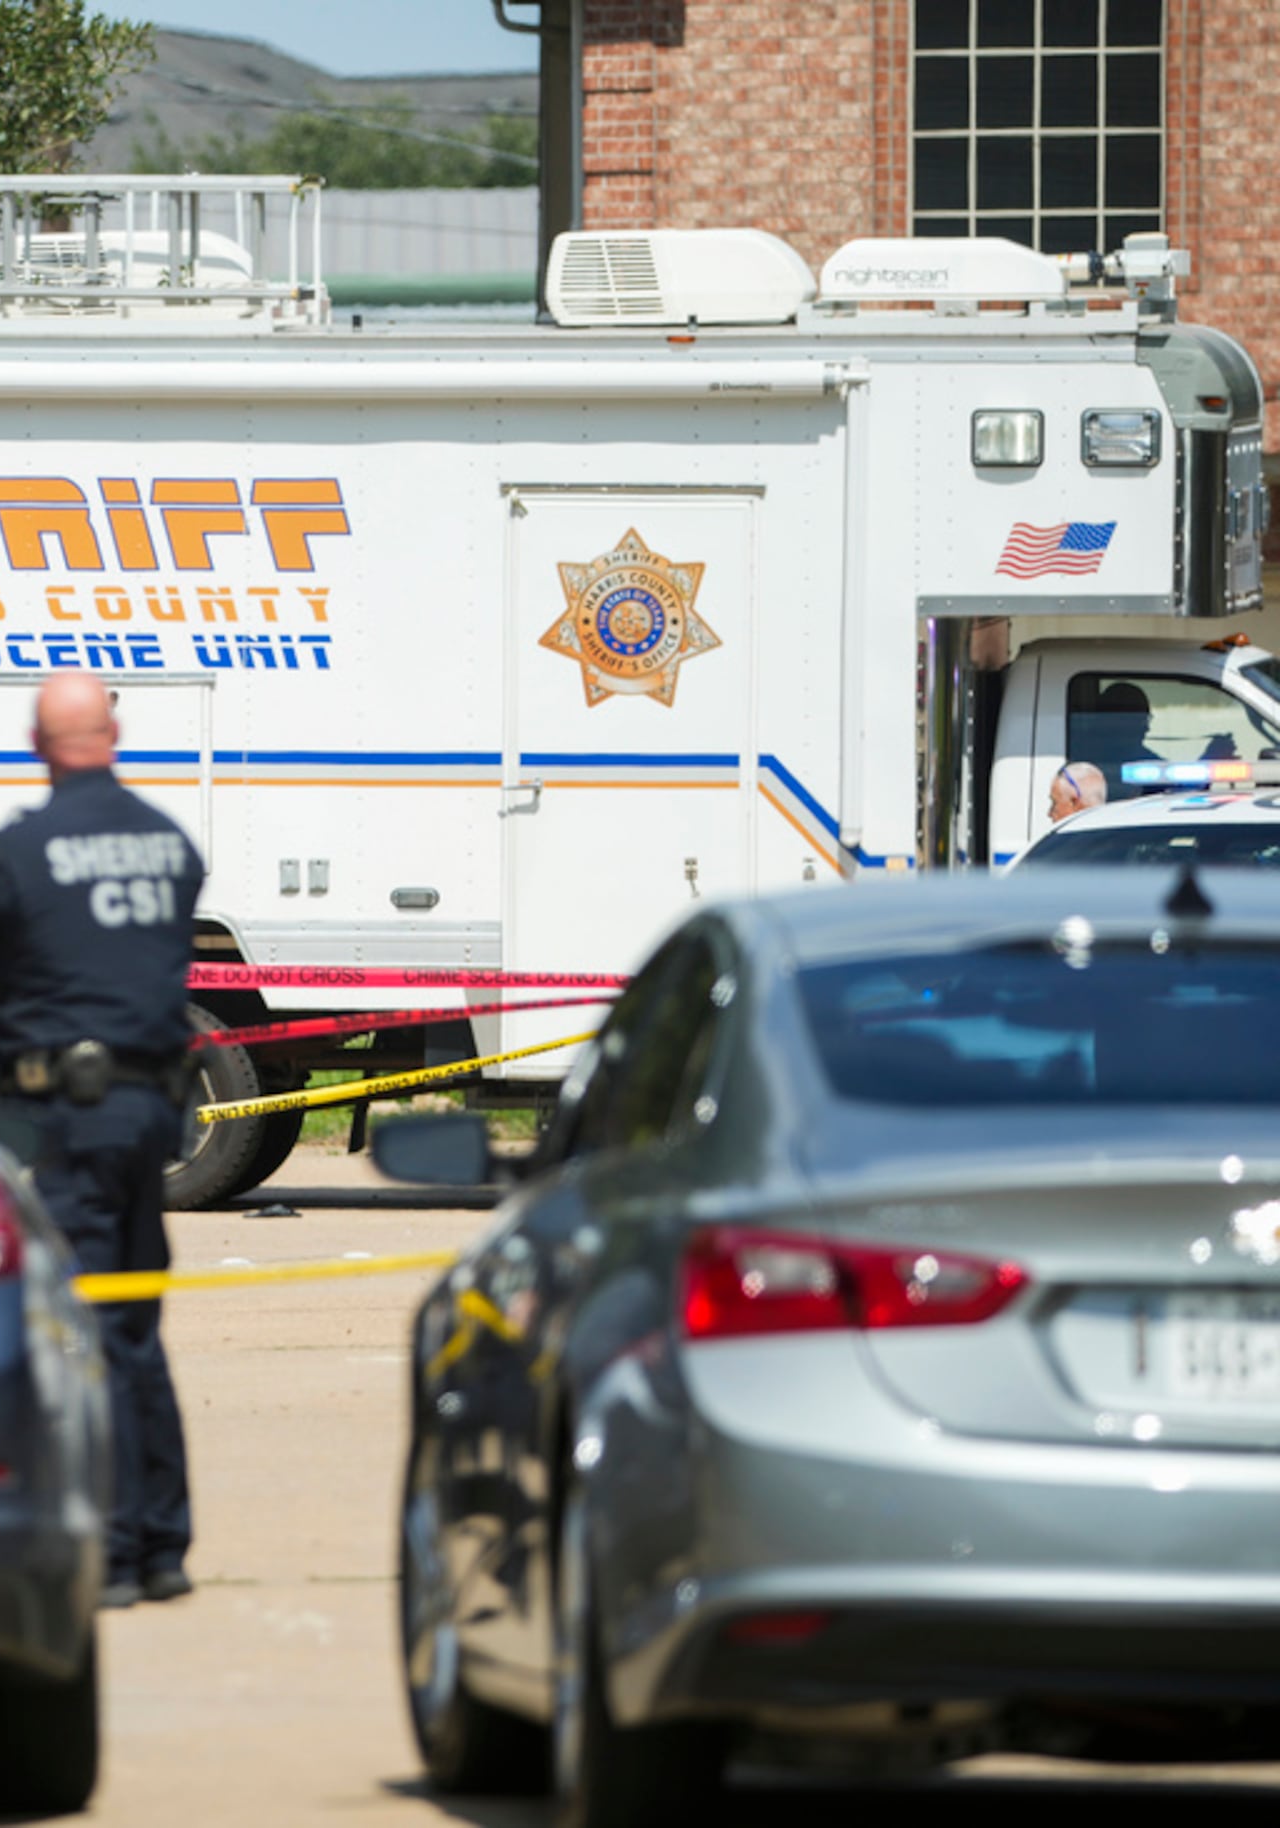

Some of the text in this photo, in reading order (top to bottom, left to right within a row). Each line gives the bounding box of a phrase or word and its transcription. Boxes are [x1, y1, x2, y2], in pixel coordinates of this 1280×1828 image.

[603, 552, 659, 567] SHERIFF
[45, 586, 331, 622] COUNTY
[585, 572, 677, 611] HARRIS COUNTY
[192, 634, 332, 669] UNIT
[642, 632, 678, 669] OFFICE
[45, 832, 186, 885] SHERIFF
[89, 877, 175, 928] CSI
[223, 967, 250, 984] DO
[255, 967, 293, 984] NOT
[299, 967, 366, 984] CROSS
[403, 969, 463, 985] CRIME
[469, 970, 531, 985] SCENE
[537, 972, 562, 985] DO
[570, 972, 608, 985] NOT
